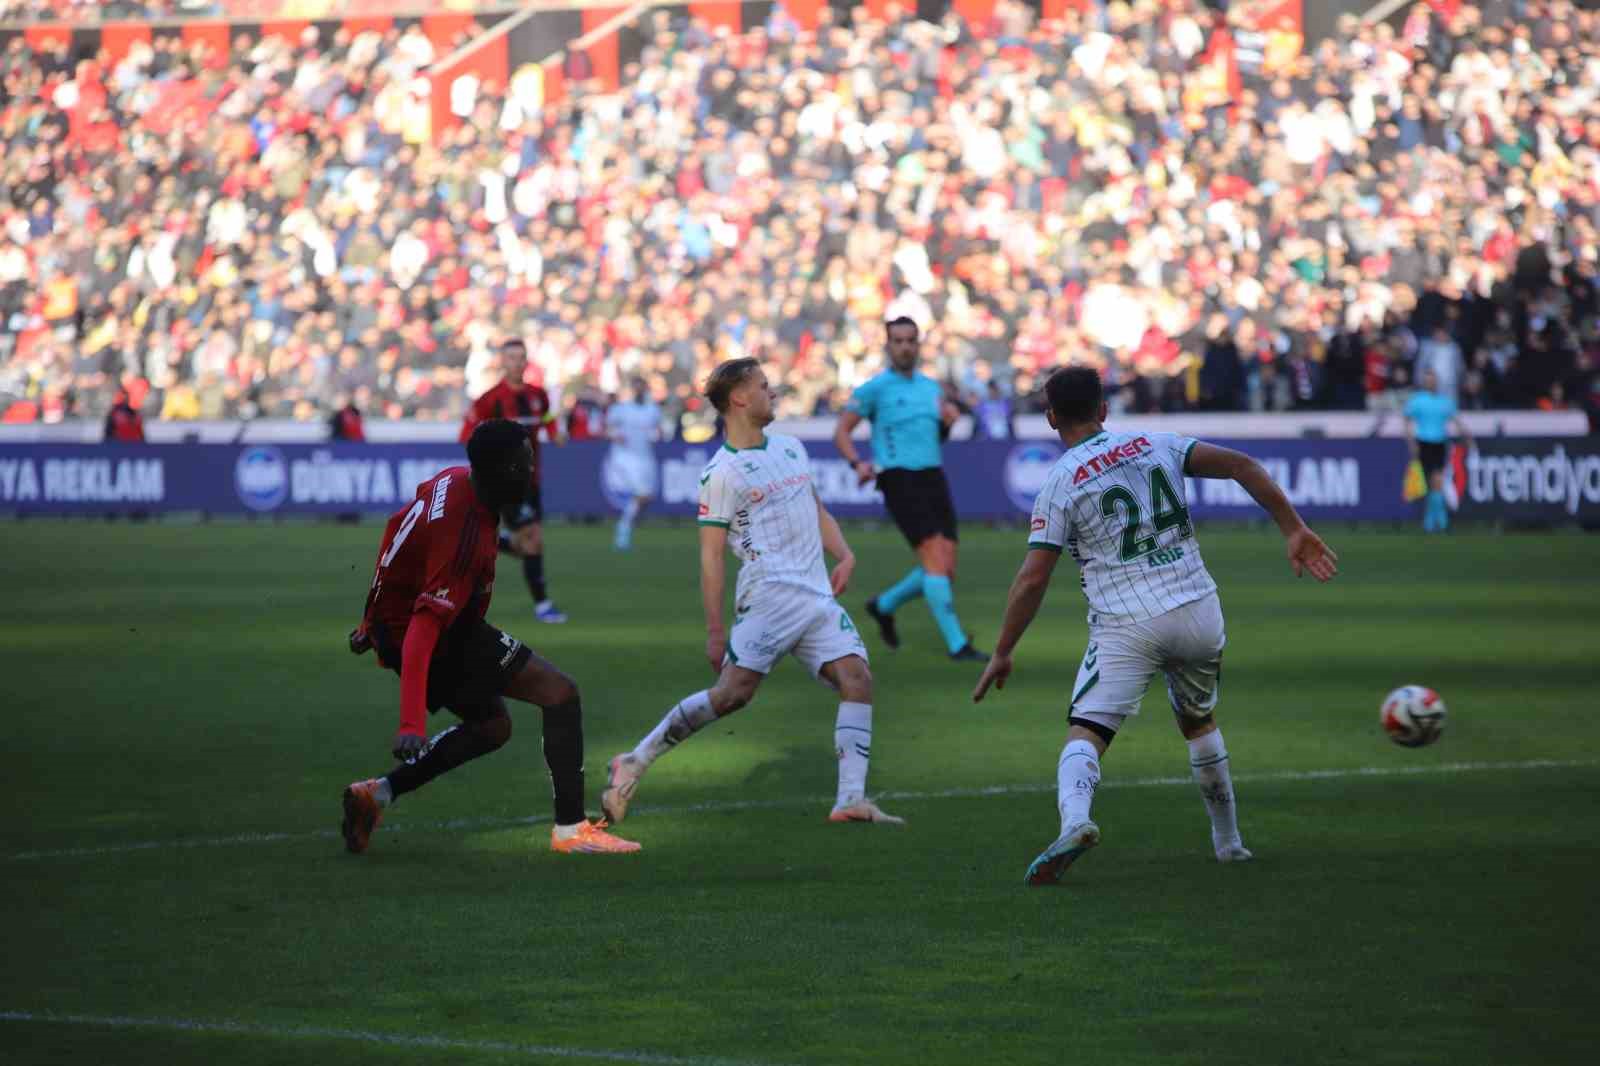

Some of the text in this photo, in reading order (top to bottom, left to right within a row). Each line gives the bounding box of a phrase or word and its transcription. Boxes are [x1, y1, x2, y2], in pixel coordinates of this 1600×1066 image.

[44, 458, 164, 502] REKLAM
[1073, 437, 1152, 486] ATIKER
[1100, 464, 1192, 562] 24
